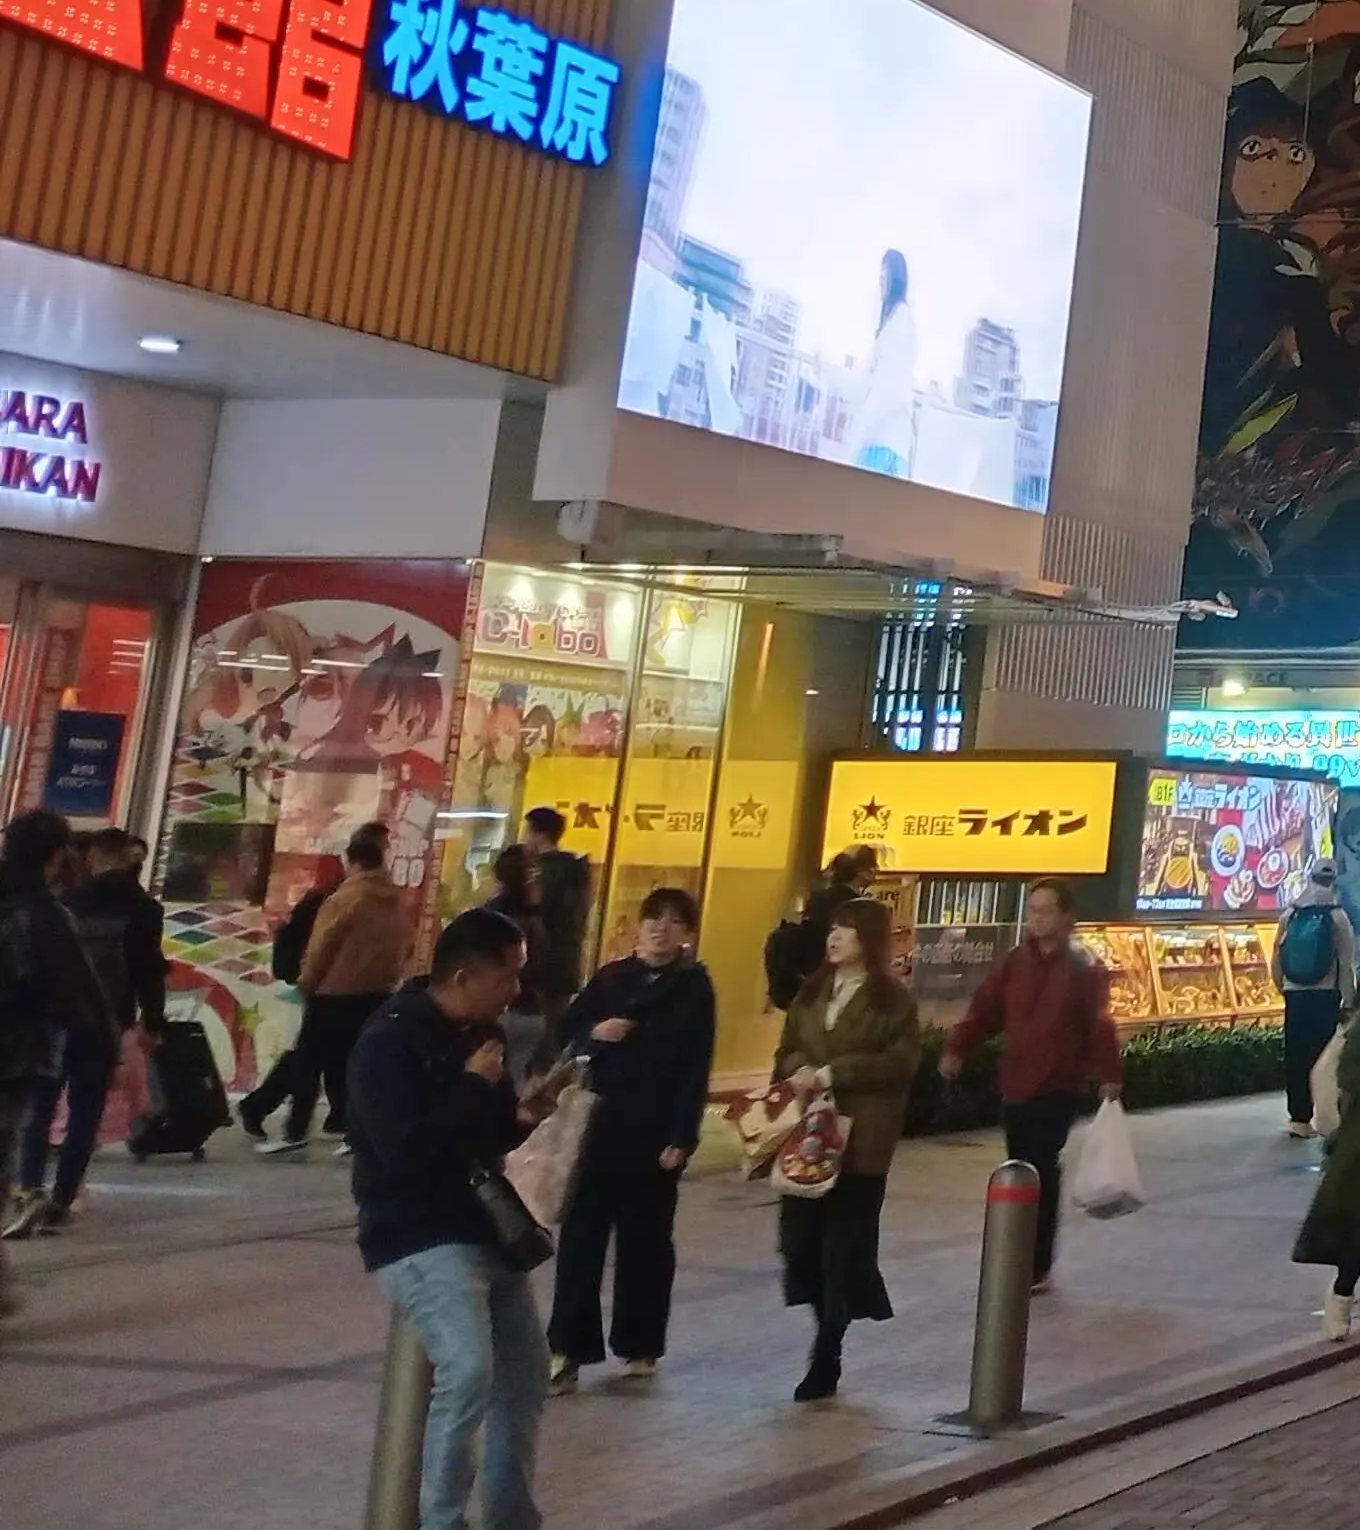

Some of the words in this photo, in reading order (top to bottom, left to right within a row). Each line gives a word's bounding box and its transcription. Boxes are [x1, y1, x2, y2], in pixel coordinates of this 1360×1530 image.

[903, 807, 1088, 838] 銀座ライオン
